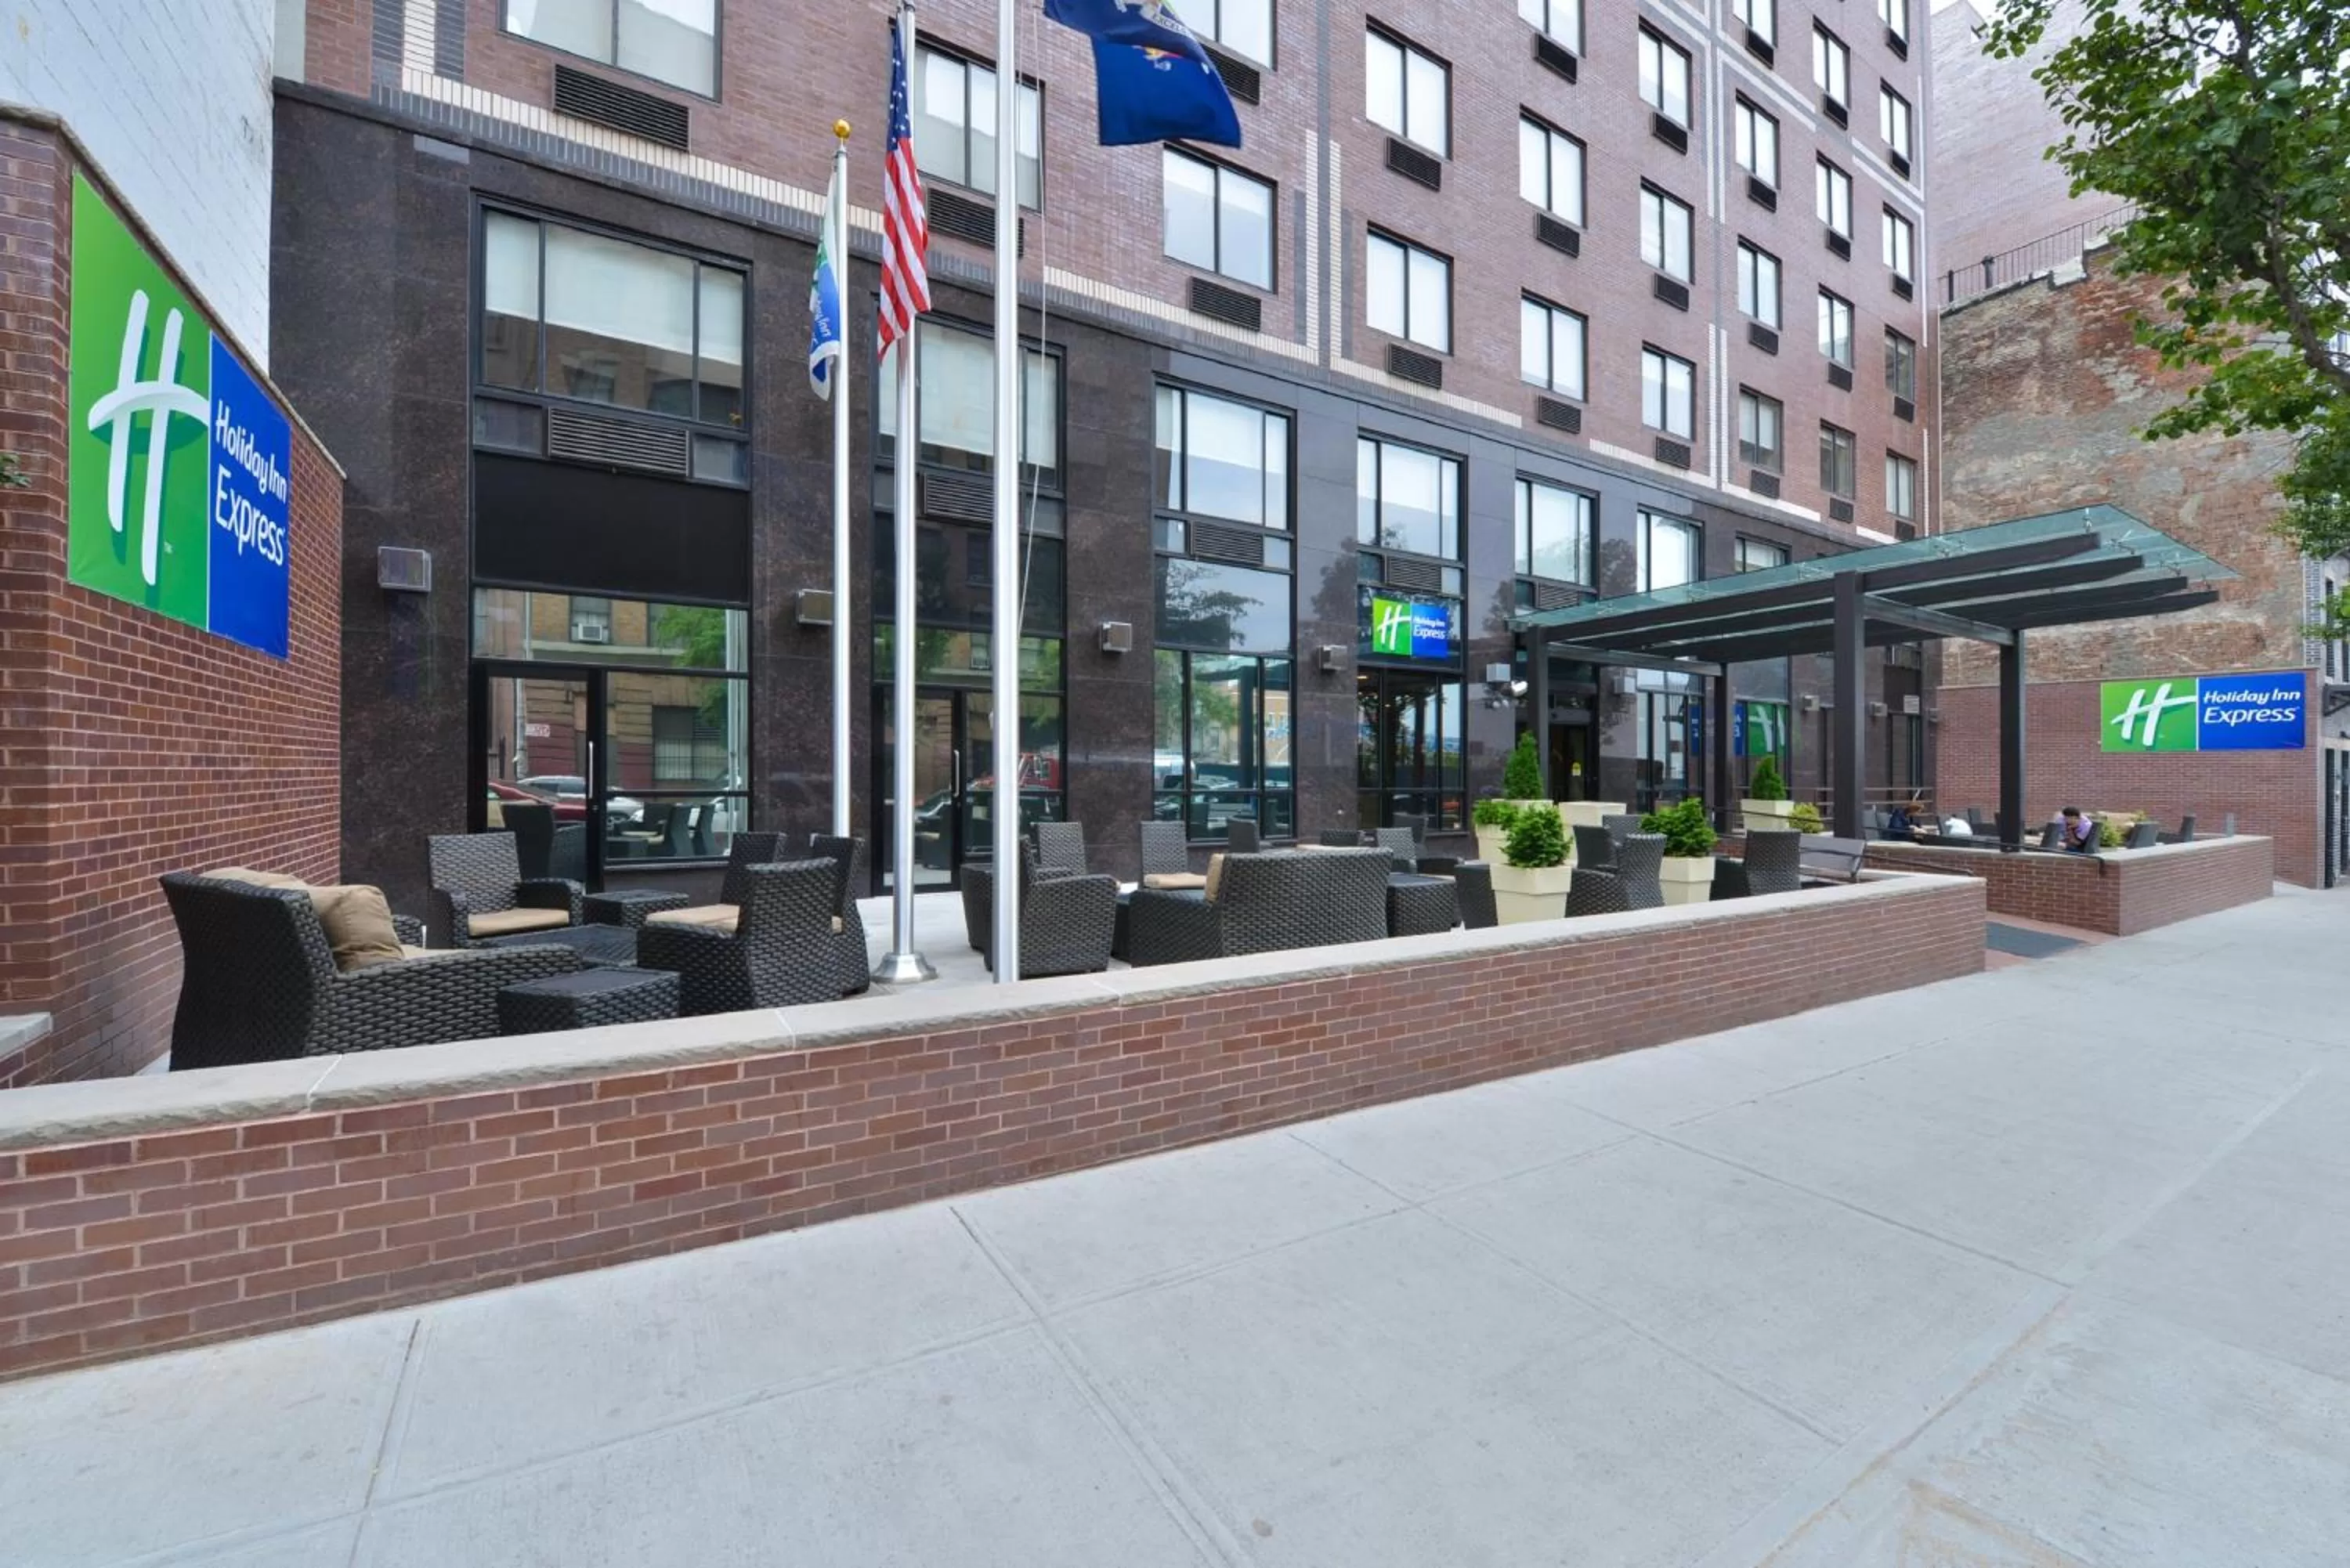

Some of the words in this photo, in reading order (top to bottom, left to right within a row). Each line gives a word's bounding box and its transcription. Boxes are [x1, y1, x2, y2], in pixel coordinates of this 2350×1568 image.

[215, 399, 269, 495] Holiday
[269, 453, 287, 504] Inn
[215, 463, 284, 566] Express
[1413, 616, 1436, 628] Holiday
[1413, 625, 1445, 640] Express
[2204, 690, 2269, 704] Holiday
[2272, 688, 2301, 701] Inn
[2204, 706, 2296, 727] Express
